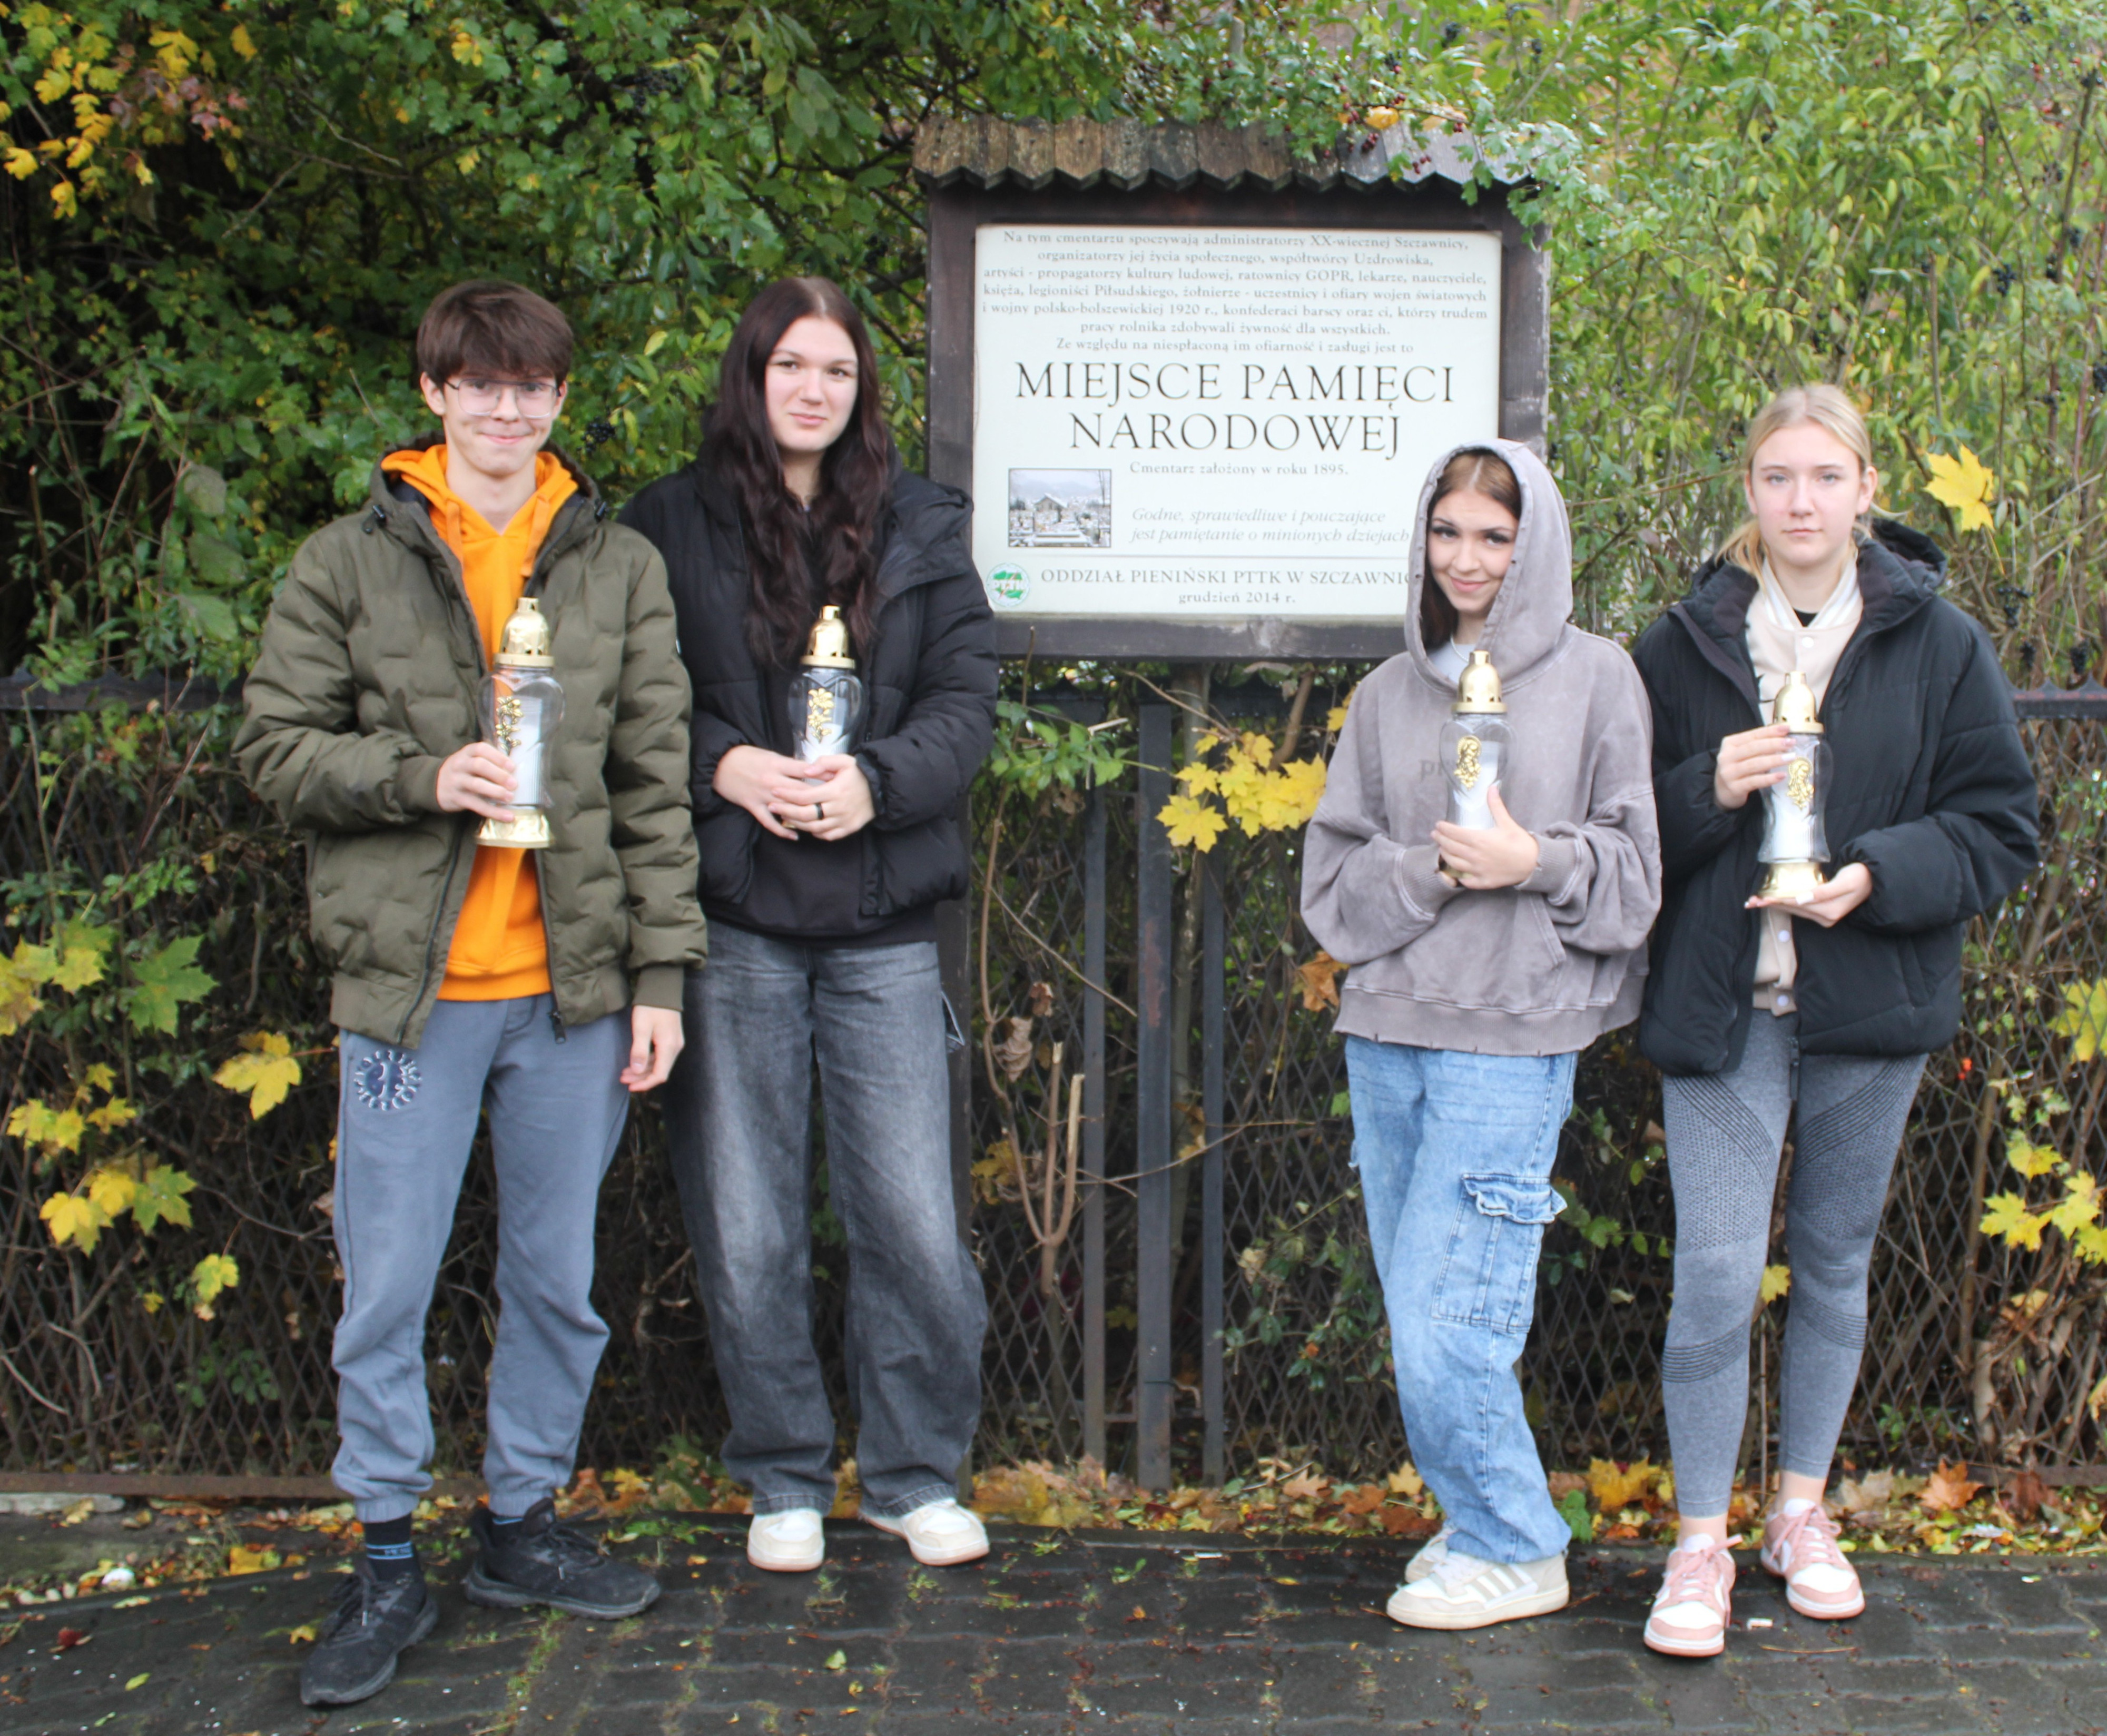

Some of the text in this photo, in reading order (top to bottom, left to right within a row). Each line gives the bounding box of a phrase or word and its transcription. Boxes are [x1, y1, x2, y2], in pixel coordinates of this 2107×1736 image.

[1003, 231, 1469, 250] Na tym cmentarzu spoczywają administratorzy XX-wiecznej Szczawnicy,
[1038, 250, 1433, 267] organizatorzy jej życia społecznego, współtwórcy Uzdrowiska,
[983, 267, 1024, 279] artyści
[1038, 270, 1122, 281] propagatorzy
[1127, 267, 1174, 281] kultury
[1178, 268, 1233, 282] ludowej,
[1238, 270, 1301, 282] ratownicy
[1305, 270, 1354, 283] GOPR,
[1358, 270, 1407, 283] lekarze,
[1412, 272, 1486, 285] nauczyciele,
[983, 283, 1025, 298] księża,
[1029, 283, 1089, 298] legioniści
[1095, 284, 1178, 299] Piłsudskiego,
[1183, 285, 1240, 298] żołnierze
[1254, 288, 1318, 300] uczestnicy
[1331, 287, 1368, 301] ofiary
[1373, 289, 1411, 302] wojen
[1416, 290, 1486, 302] światowych
[991, 302, 1029, 315] wojny
[1034, 301, 1164, 317] polsko-bolszewickiej
[1170, 304, 1200, 315] 1920
[1223, 303, 1297, 316] konfederaci
[1303, 304, 1342, 318] barscy
[1346, 309, 1373, 318] oraz
[1397, 306, 1436, 319] którzy
[1441, 307, 1487, 319] trudem
[1081, 320, 1390, 336] pracy rolnika zdobywali żywność dla wszystkich.
[1057, 337, 1071, 349] Ze
[1076, 338, 1128, 352] względu
[1153, 338, 1229, 353] niespłaconą
[1234, 340, 1251, 351] im
[1255, 339, 1314, 352] ofiarność
[1328, 340, 1370, 354] zasługi
[1374, 341, 1396, 354] jest
[1401, 344, 1414, 353] to
[1016, 362, 1454, 410] MIEJSCE PAMIĘCI
[1070, 413, 1400, 459] NARODOWEJ
[1129, 461, 1194, 474] Cmentarz
[1200, 462, 1256, 475] założony
[1277, 462, 1307, 475] roku
[1314, 464, 1348, 475] 1895.
[1132, 507, 1184, 522] Godne,
[1189, 508, 1287, 525] sprawiedliwe
[1299, 510, 1386, 526] pouczające
[1130, 528, 1156, 543] jest
[1158, 528, 1245, 544] pamiętanie
[1248, 531, 1258, 541] o
[1262, 528, 1342, 545] minionych
[1041, 569, 1125, 583] ODDZIAŁ
[1131, 567, 1226, 584] PIENIŃSKI
[1234, 570, 1281, 584] PTTK
[1287, 571, 1304, 583] W
[1179, 590, 1240, 605] grudzień
[1246, 591, 1279, 603] 2014
